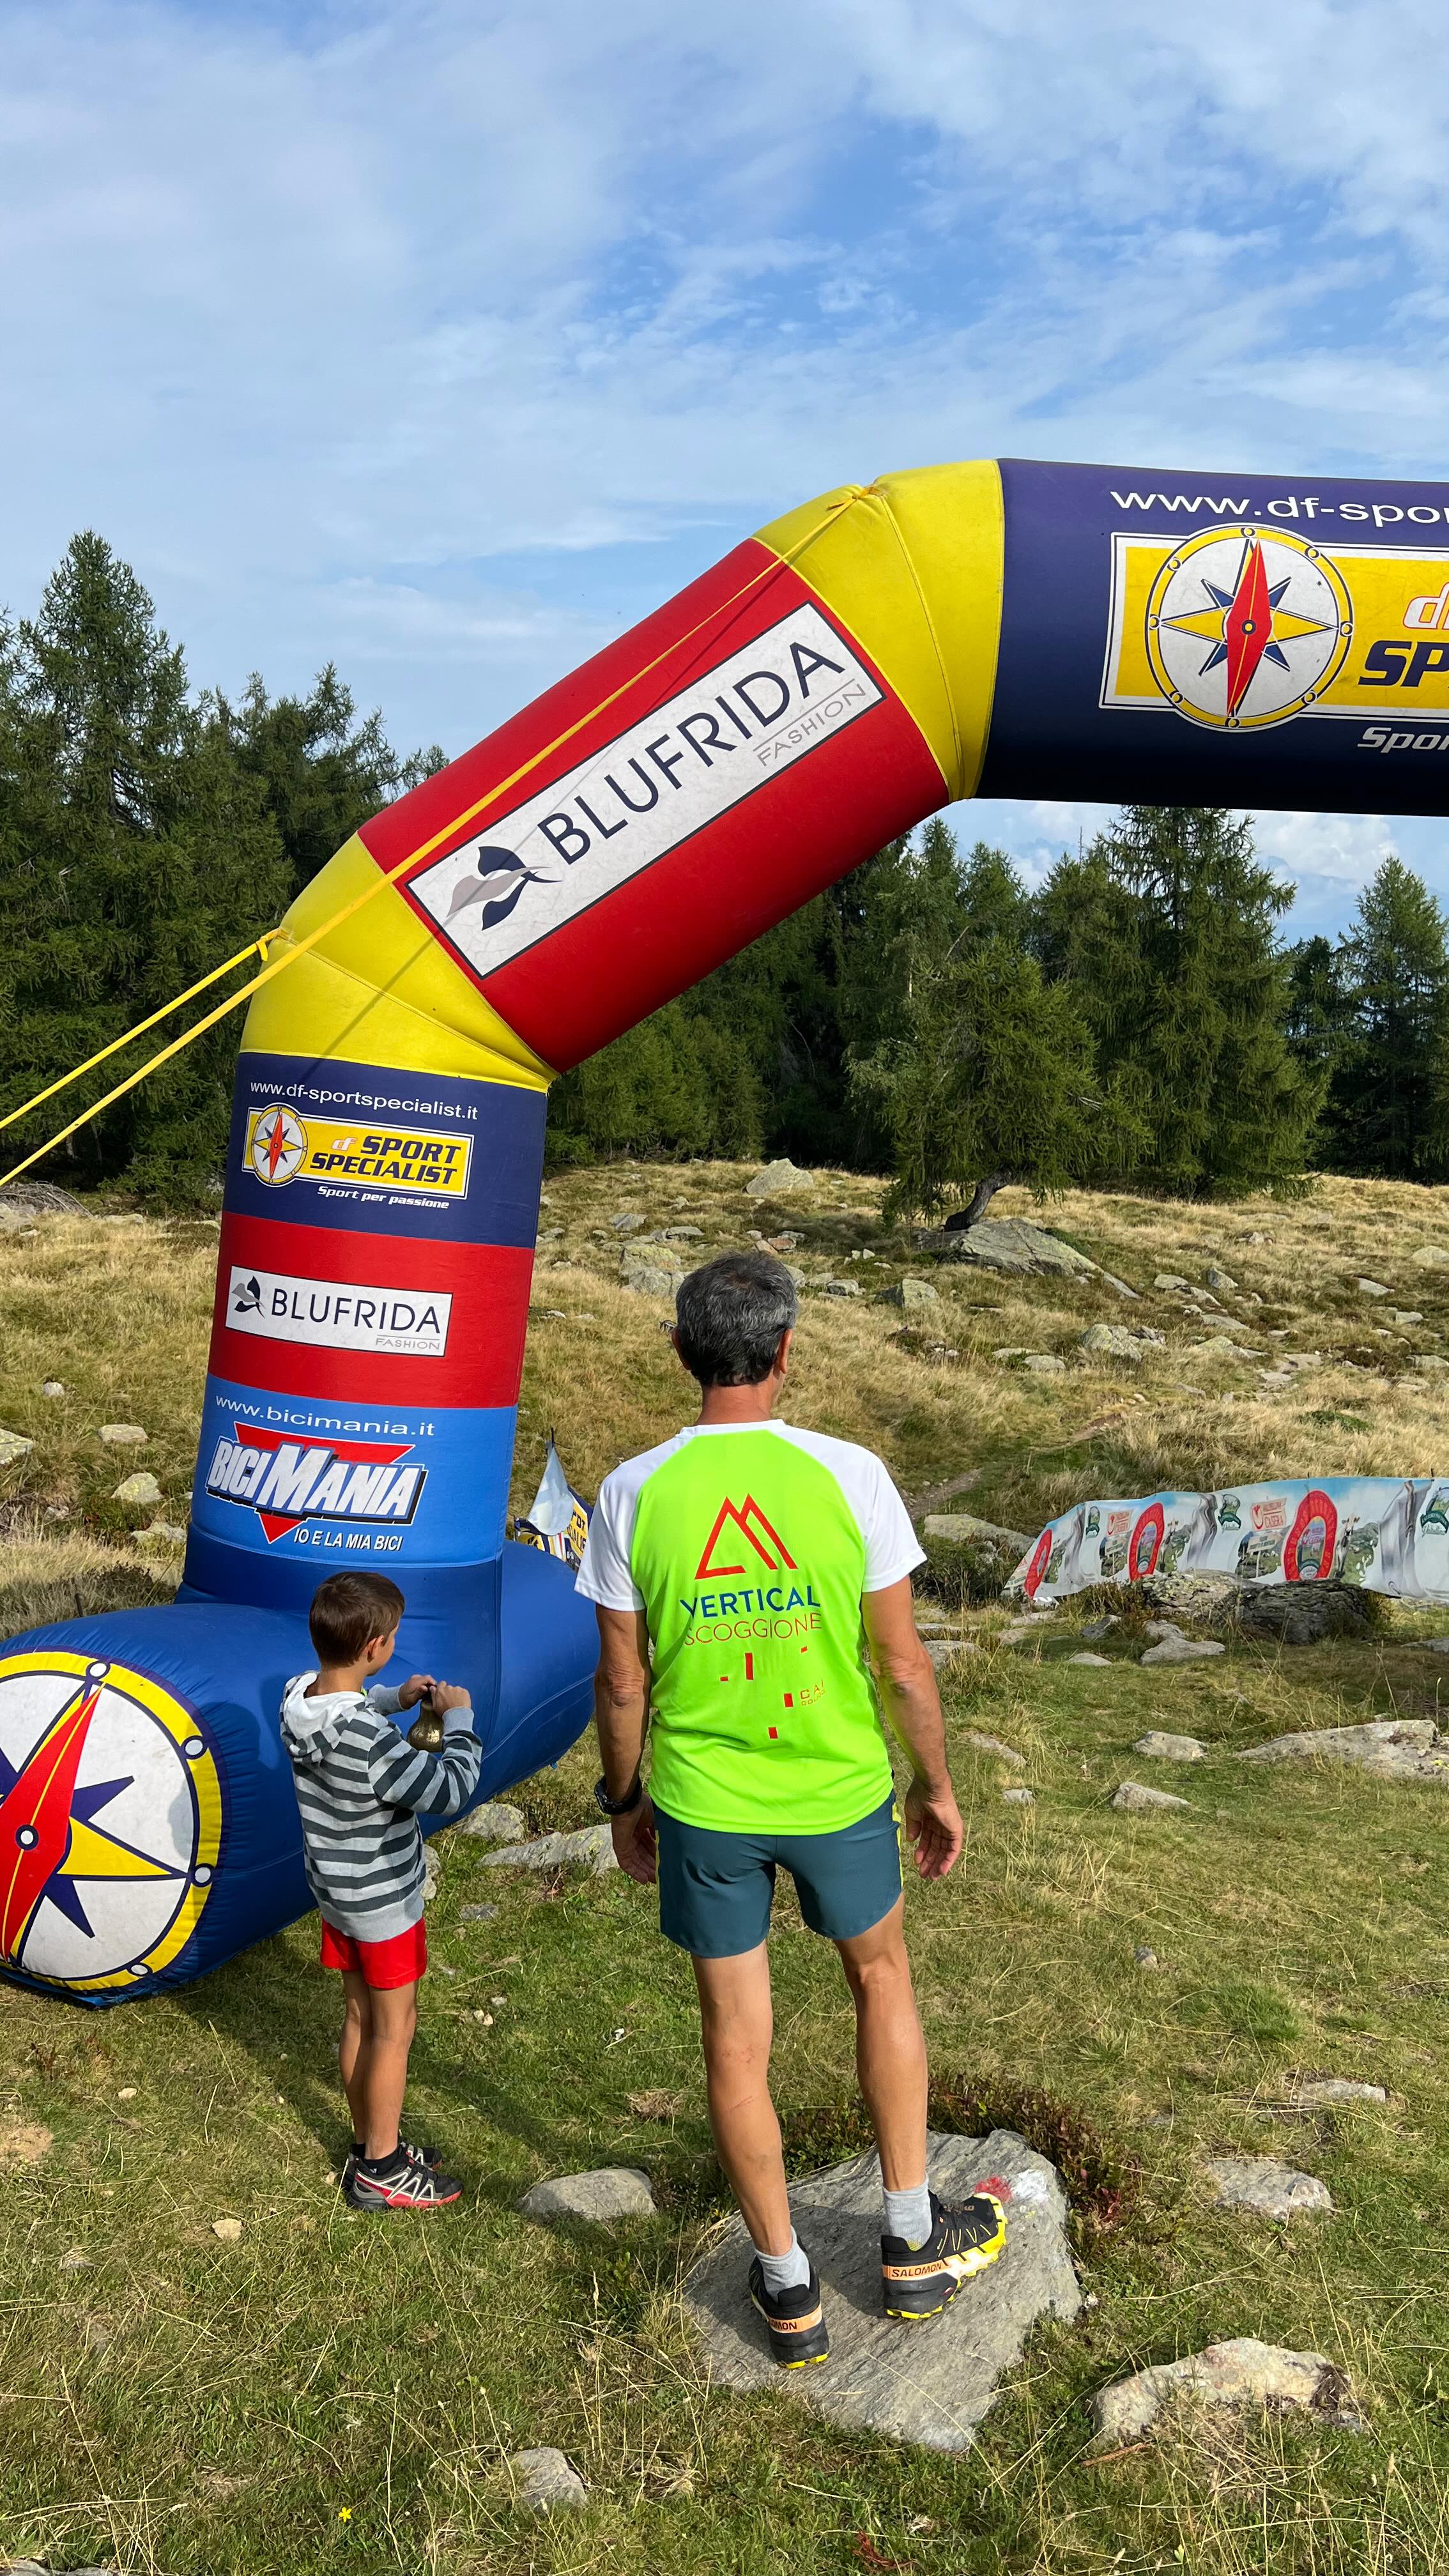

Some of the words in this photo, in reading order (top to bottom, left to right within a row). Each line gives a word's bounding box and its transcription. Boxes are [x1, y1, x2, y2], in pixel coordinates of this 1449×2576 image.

[756, 684, 866, 767] FASHION
[537, 641, 846, 865] BLUFRIDA
[250, 1082, 478, 1120] www.df-sportspecialist.it
[360, 1135, 461, 1164] SPORT
[310, 1152, 457, 1184] SPECIALIST
[317, 1186, 359, 1199] Sport
[360, 1193, 387, 1202] per
[388, 1195, 450, 1209] passione
[272, 1288, 441, 1334] BLUFRIDA
[375, 1338, 440, 1350] FASHION
[216, 1395, 435, 1436] www.bicimania.it
[293, 1528, 310, 1544] IO
[311, 1530, 323, 1546] E
[324, 1531, 343, 1548] LA
[346, 1533, 371, 1550] MIA
[374, 1535, 404, 1551] BICI
[679, 1585, 821, 1620] VERTICAL
[684, 1612, 822, 1646] SCOGGIONE
[891, 2262, 942, 2278] SALOMON
